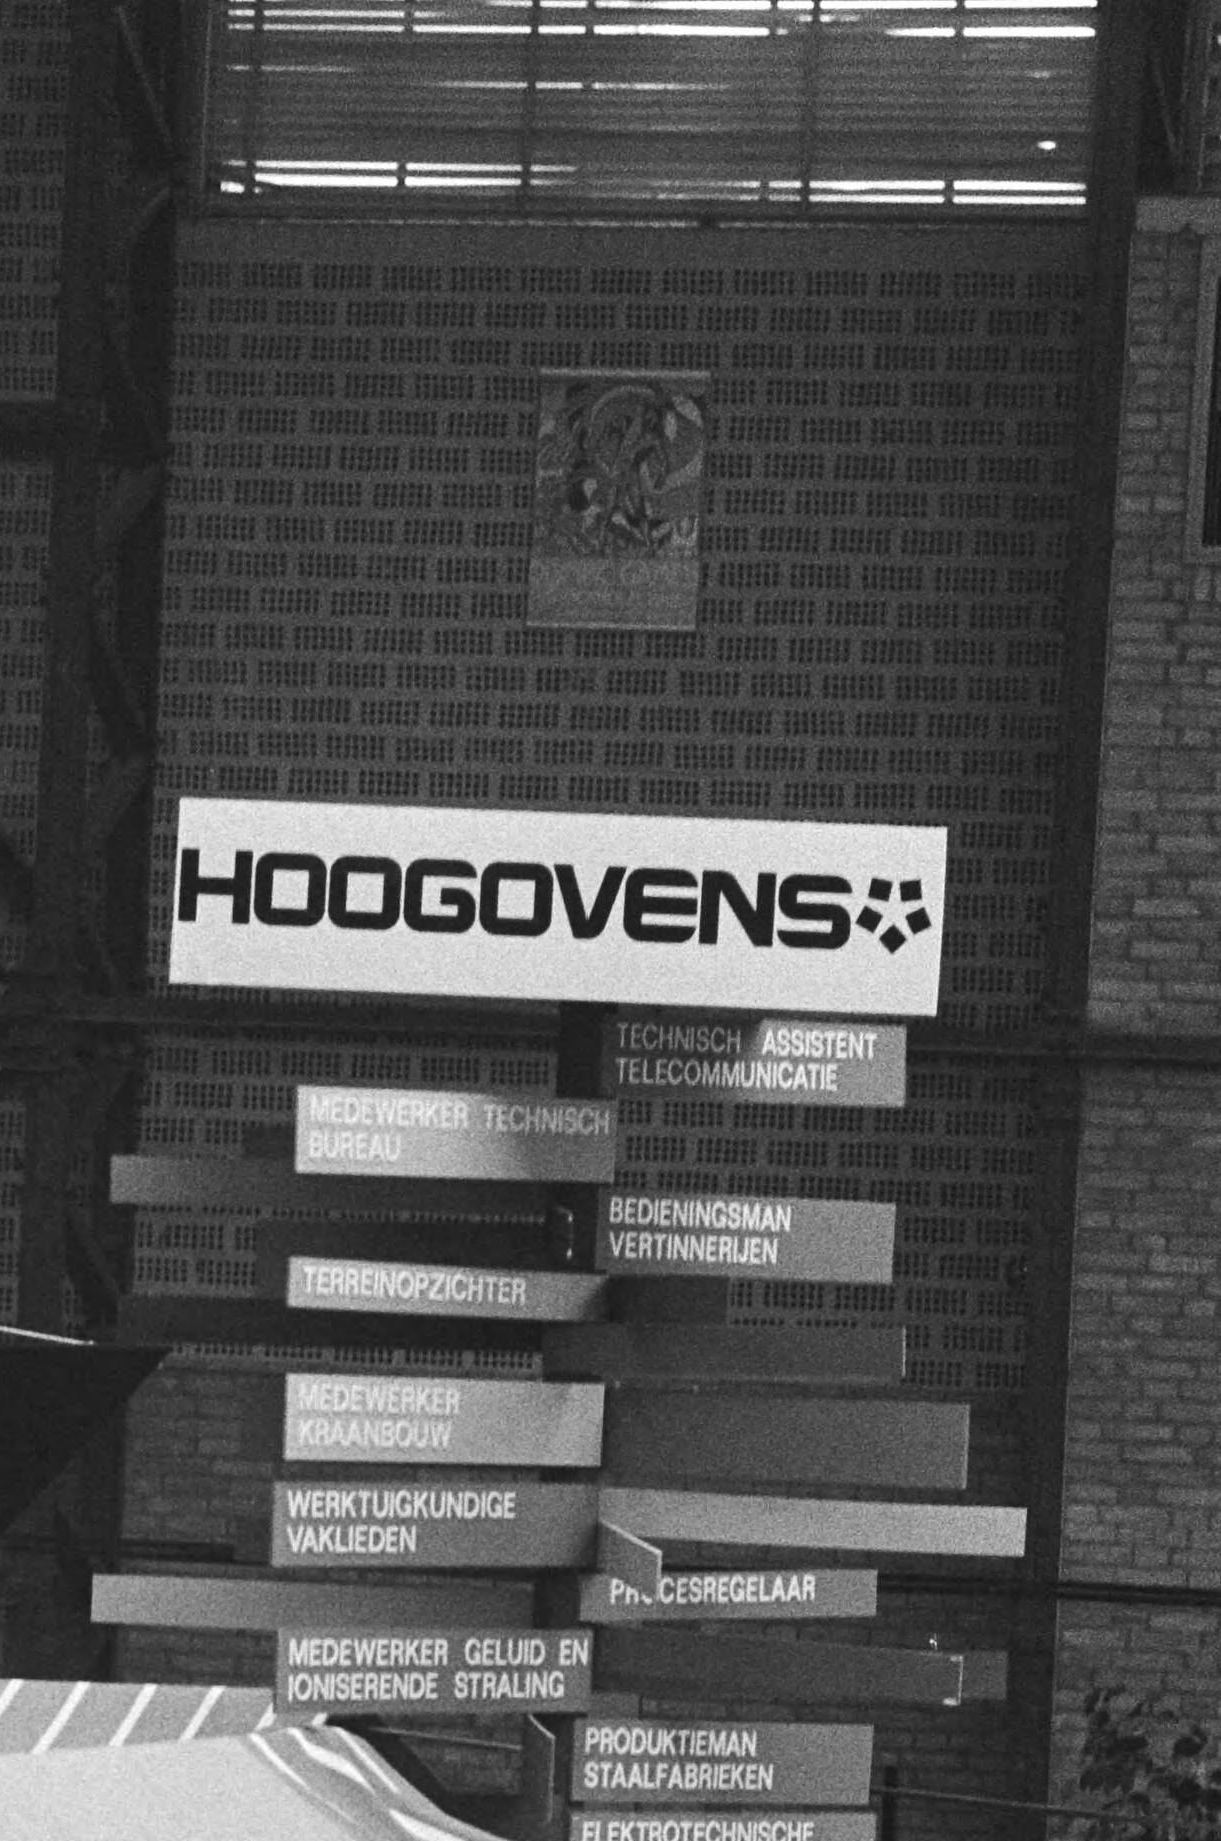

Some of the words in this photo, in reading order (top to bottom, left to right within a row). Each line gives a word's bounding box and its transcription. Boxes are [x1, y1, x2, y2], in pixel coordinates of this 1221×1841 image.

[178, 848, 851, 950] HOOGOVENS
[617, 1022, 741, 1053] TECHNISCH
[761, 1028, 877, 1060] ASSISTENT
[615, 1057, 838, 1091] TELECOMMUNICATIE
[309, 1094, 468, 1128] MEDEWERKER
[483, 1104, 610, 1135] TECHNISCH
[308, 1130, 402, 1161] BUREAU
[609, 1196, 792, 1232] BEDIENINGSMAN
[609, 1231, 778, 1264] VERTINNERIJEN
[302, 1265, 527, 1305] TERREINOPZICHTER
[298, 1383, 461, 1415] MEDEWERKER
[298, 1418, 453, 1448] KRAANBOUW
[287, 1489, 517, 1519] WERKTUIGKUNDIGE
[286, 1524, 417, 1553] VAKLIEDEN
[610, 1574, 816, 1605] PRCESREGELAAR
[288, 1637, 448, 1667] MEDEWERKER
[464, 1637, 546, 1667] GELUID
[559, 1638, 588, 1667] EN
[288, 1672, 439, 1702] IONISERENDE
[454, 1670, 565, 1699] STRALING
[584, 1726, 757, 1757] PRODUKTIEMAN
[584, 1761, 774, 1791] STAALFABRIEKEN
